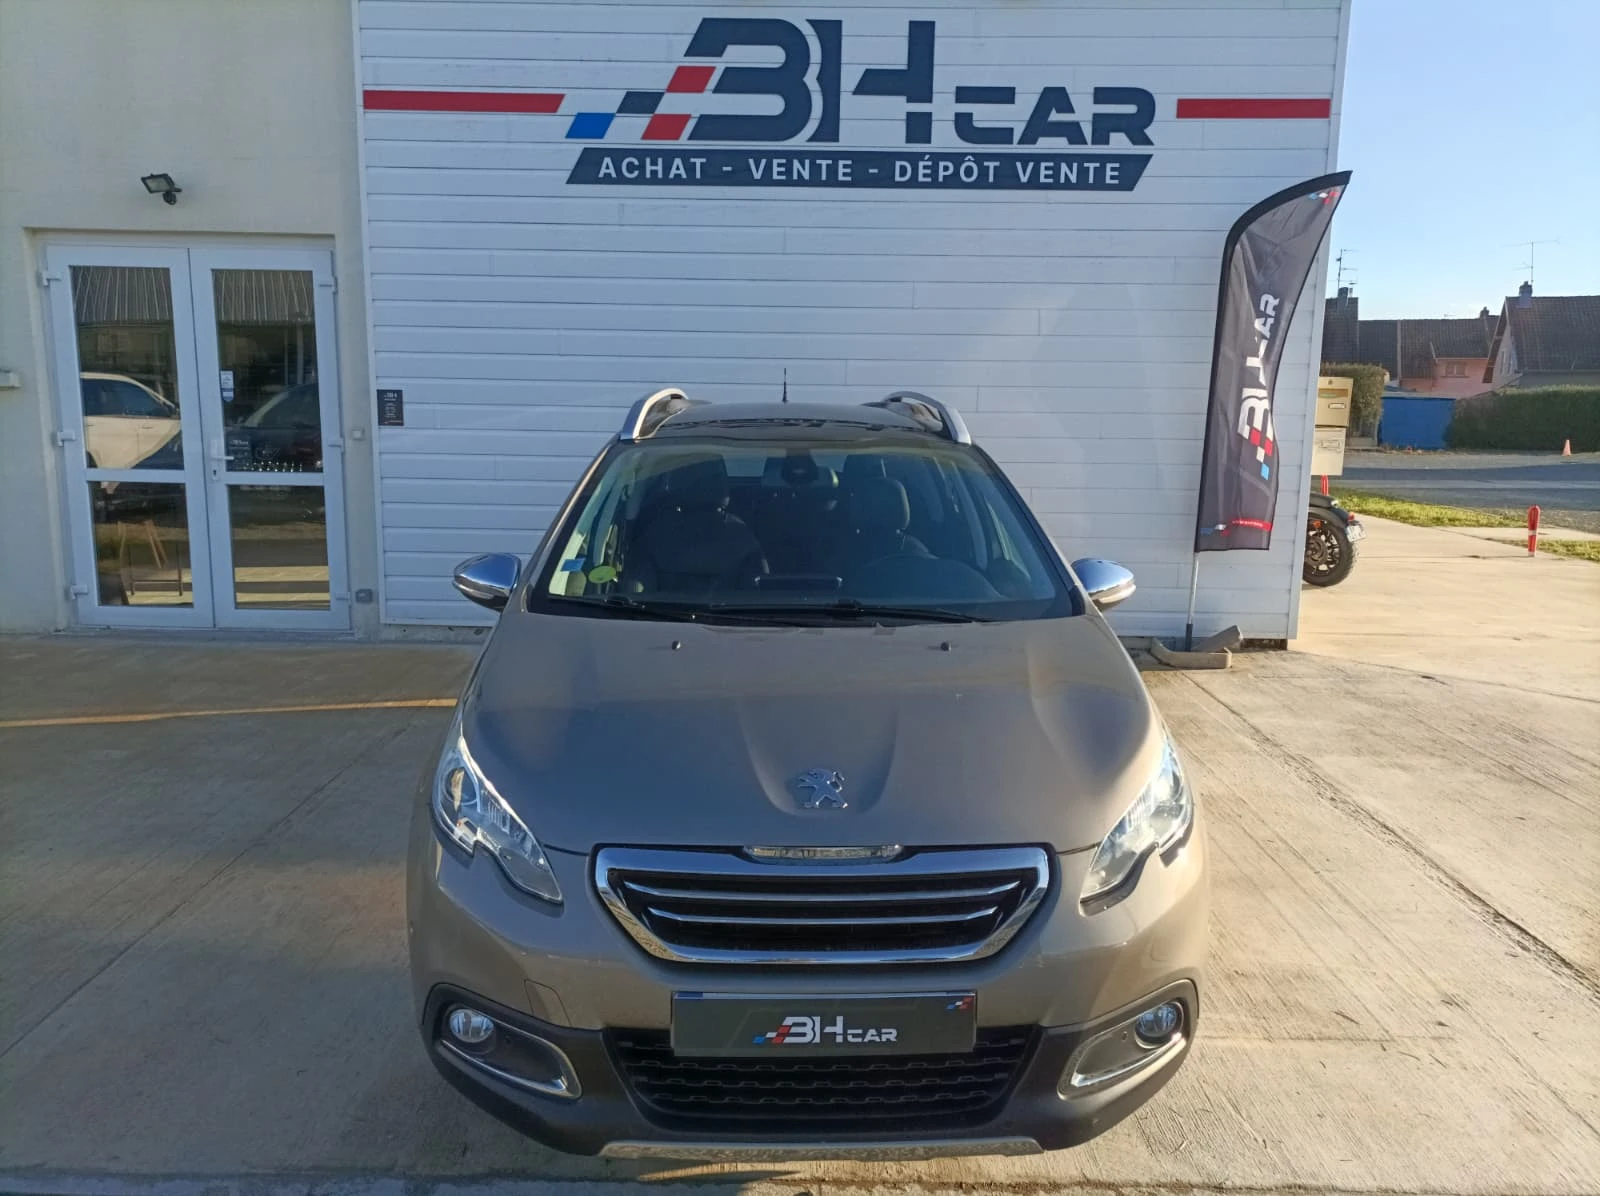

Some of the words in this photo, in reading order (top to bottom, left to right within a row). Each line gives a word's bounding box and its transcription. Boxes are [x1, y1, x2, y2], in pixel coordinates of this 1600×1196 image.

[684, 17, 935, 144] BH
[954, 86, 1156, 146] CAR
[598, 157, 707, 179] ACHAT
[748, 158, 853, 181] VENTE
[894, 155, 1000, 183] DÉPÔT
[1015, 161, 1121, 184] VENTE
[783, 1016, 844, 1043] BH
[847, 1028, 898, 1043] CAR
